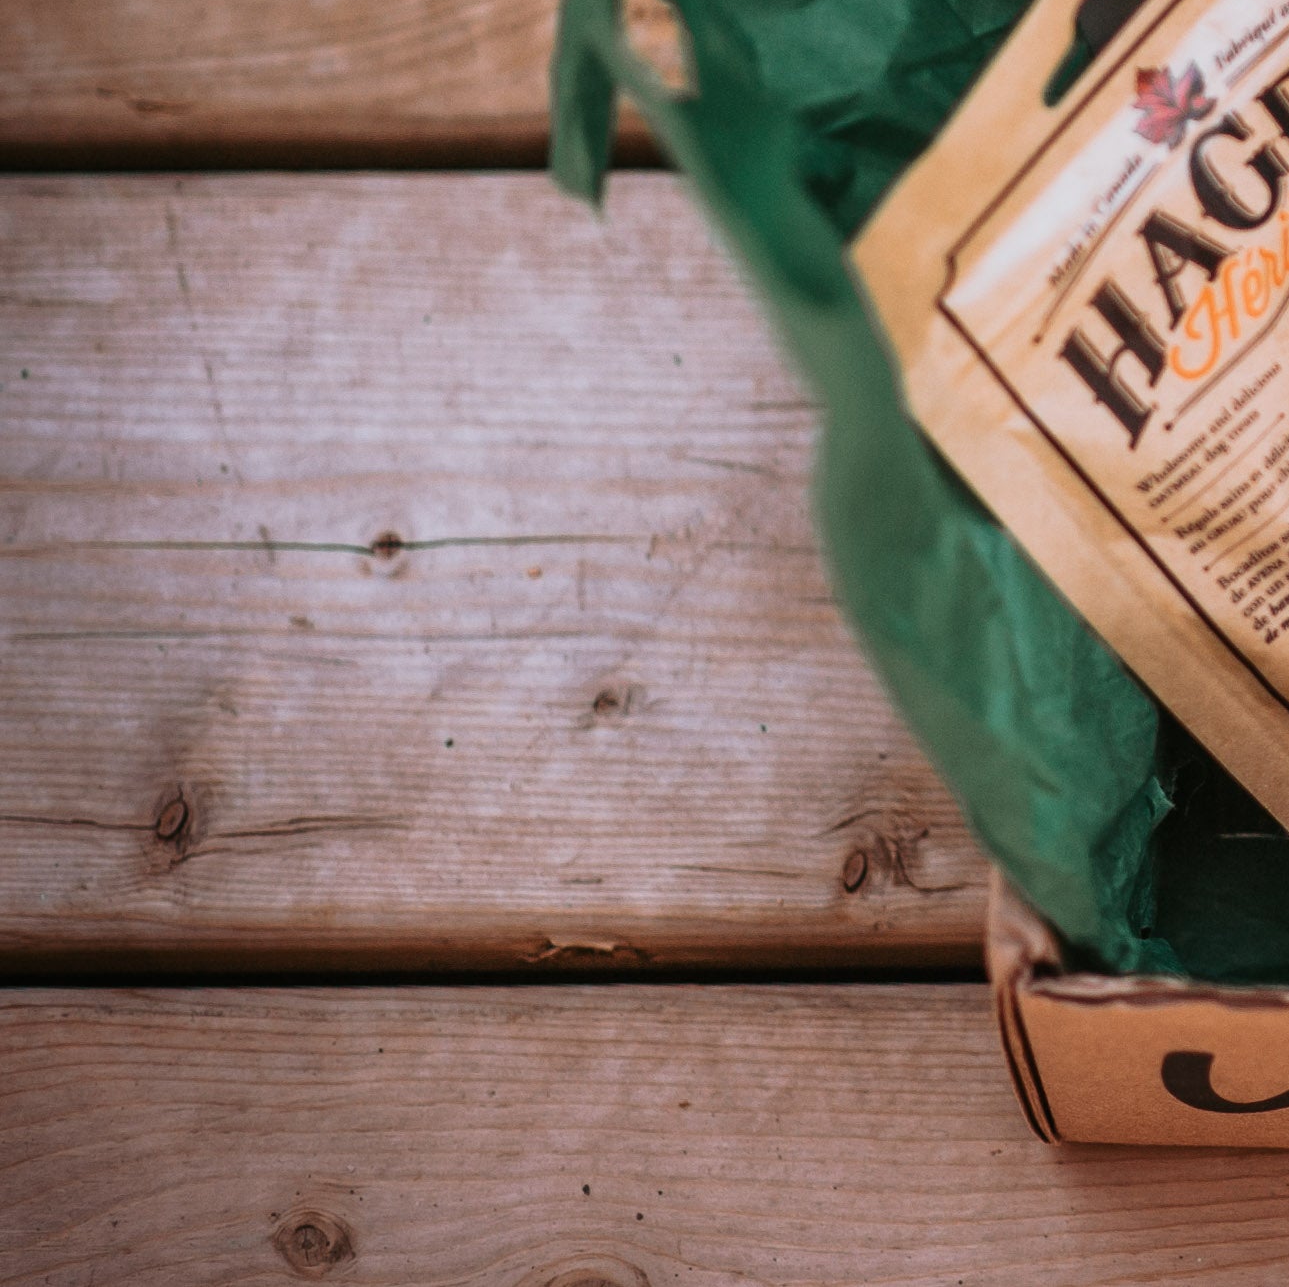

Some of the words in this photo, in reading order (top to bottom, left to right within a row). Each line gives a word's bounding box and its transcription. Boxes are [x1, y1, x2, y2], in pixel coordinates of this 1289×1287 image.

[1134, 428, 1209, 498] Wholesome
[1204, 406, 1233, 434] and
[1227, 358, 1284, 412] delicious
[1201, 437, 1231, 466] dog
[1173, 499, 1221, 545] Régals
[1216, 477, 1251, 510] sains
[1187, 536, 1208, 557] au
[1244, 479, 1280, 514] pour
[1216, 533, 1280, 594] Bocaditos
[1227, 584, 1248, 604] de
[1245, 554, 1285, 591] AVENA
[1239, 592, 1266, 619] con
[1263, 575, 1285, 597] un
[1250, 612, 1271, 632] de
[1260, 625, 1281, 645] de
